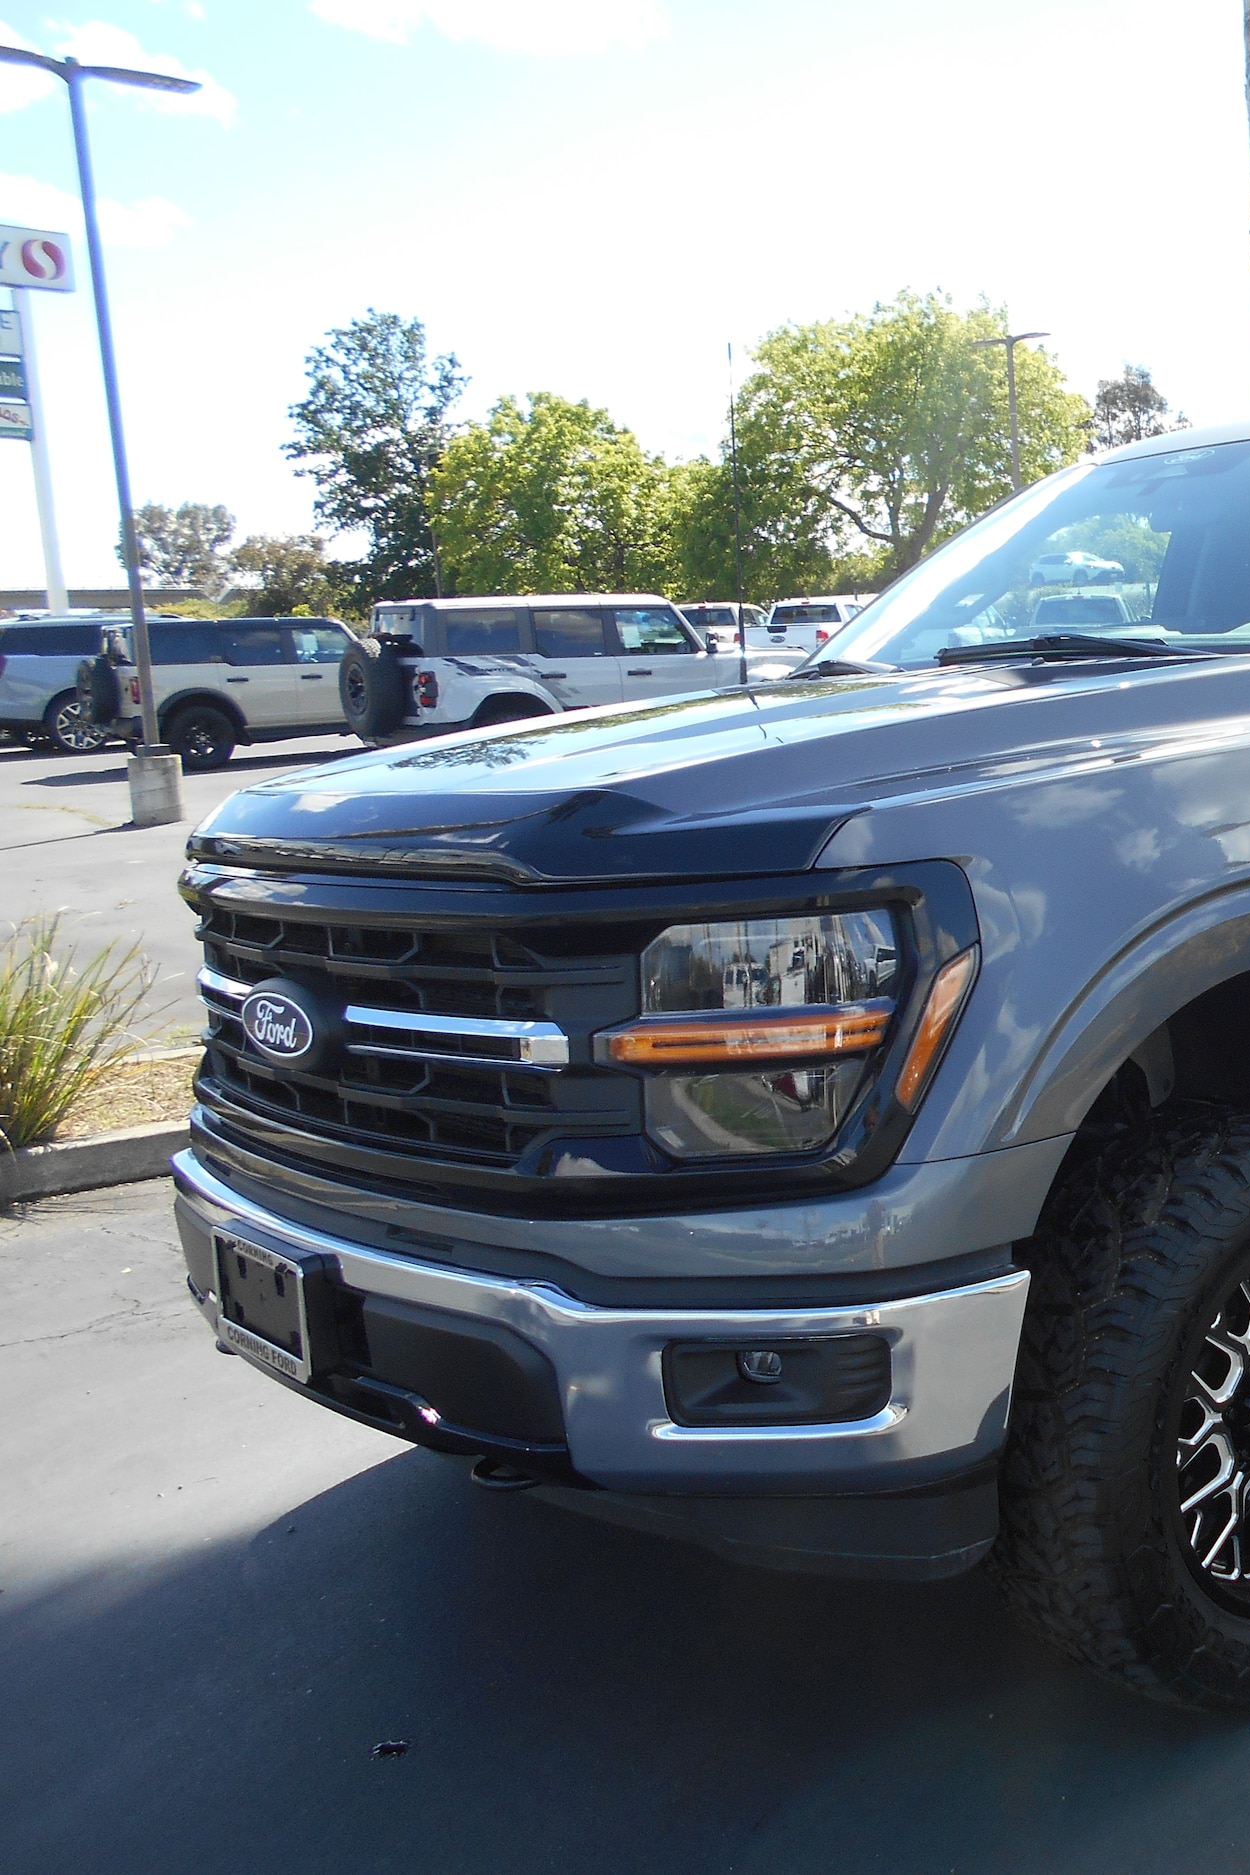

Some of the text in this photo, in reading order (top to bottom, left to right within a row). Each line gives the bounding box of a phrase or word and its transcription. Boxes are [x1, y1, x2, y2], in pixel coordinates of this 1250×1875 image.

[255, 999, 297, 1048] Ford
[227, 1325, 297, 1376] CORNING FORD
